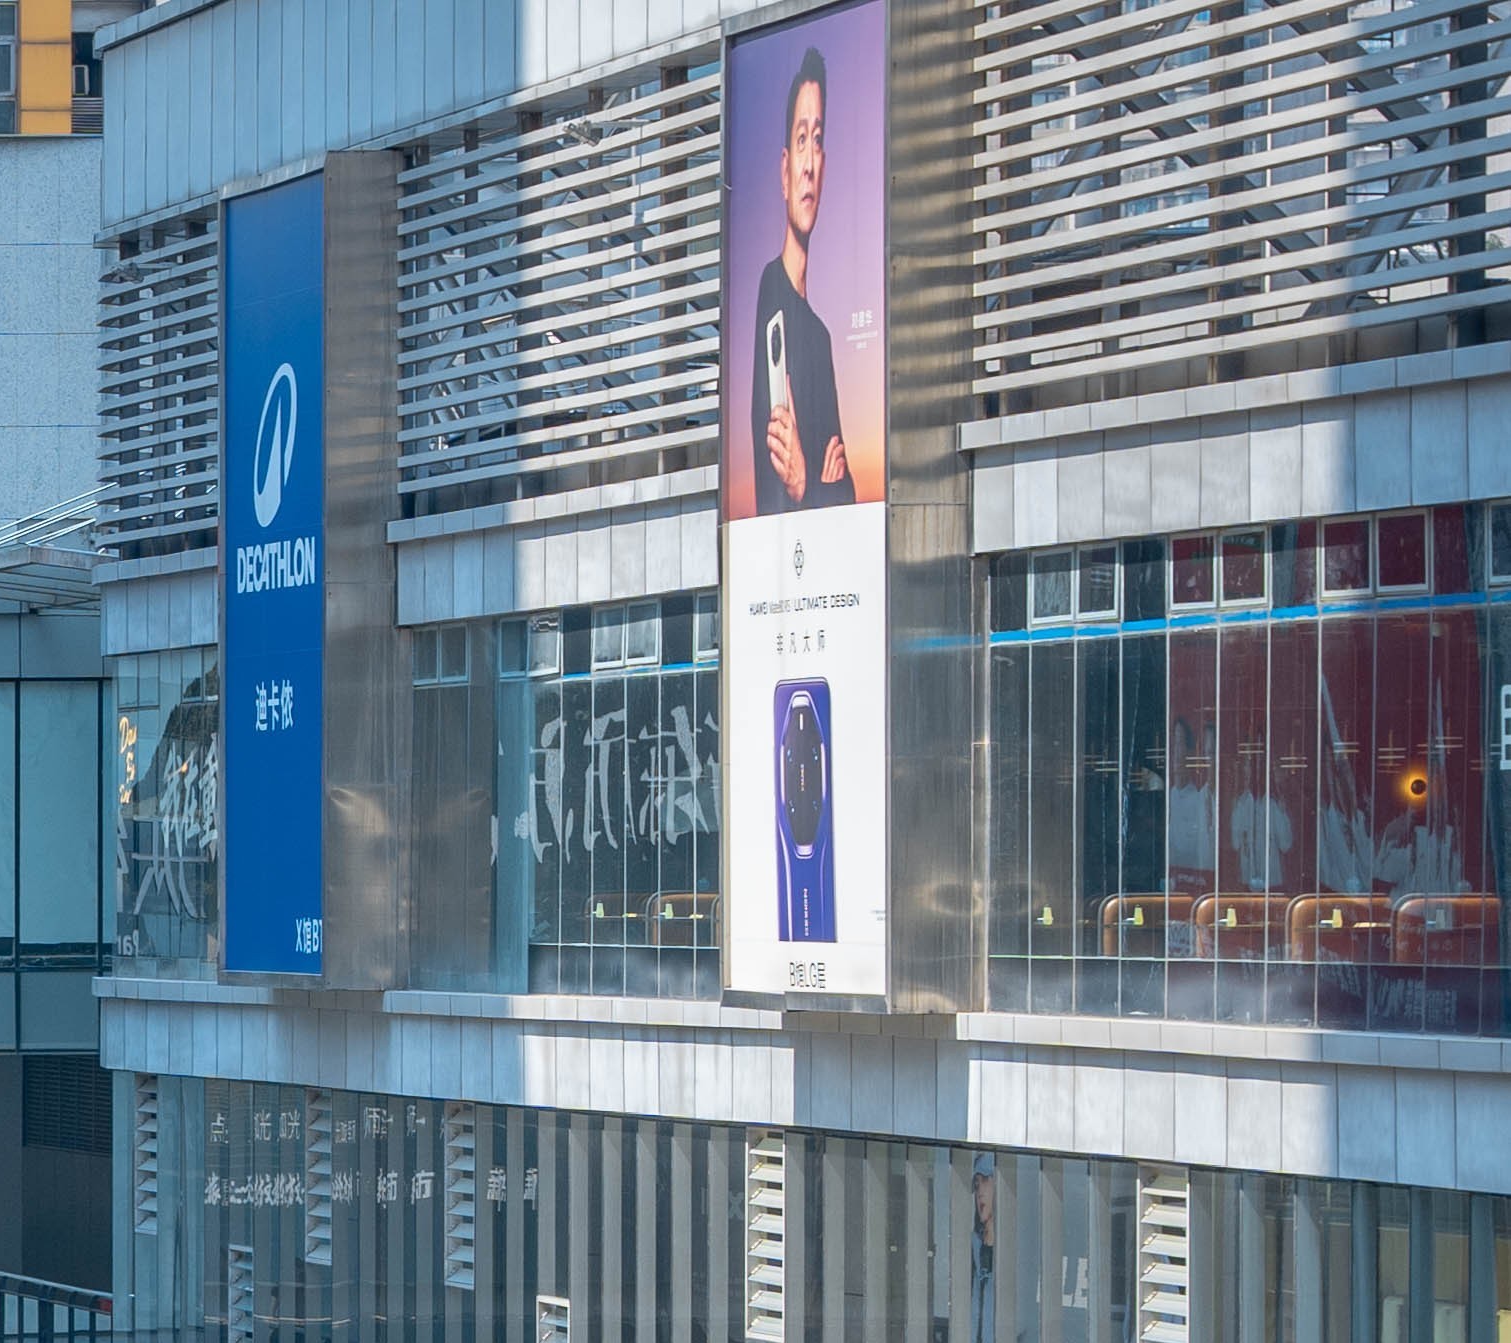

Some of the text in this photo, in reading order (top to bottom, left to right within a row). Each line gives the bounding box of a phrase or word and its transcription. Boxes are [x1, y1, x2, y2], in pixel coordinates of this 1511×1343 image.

[236, 536, 316, 595] DECATHLON
[255, 679, 294, 732] 迪卡侬
